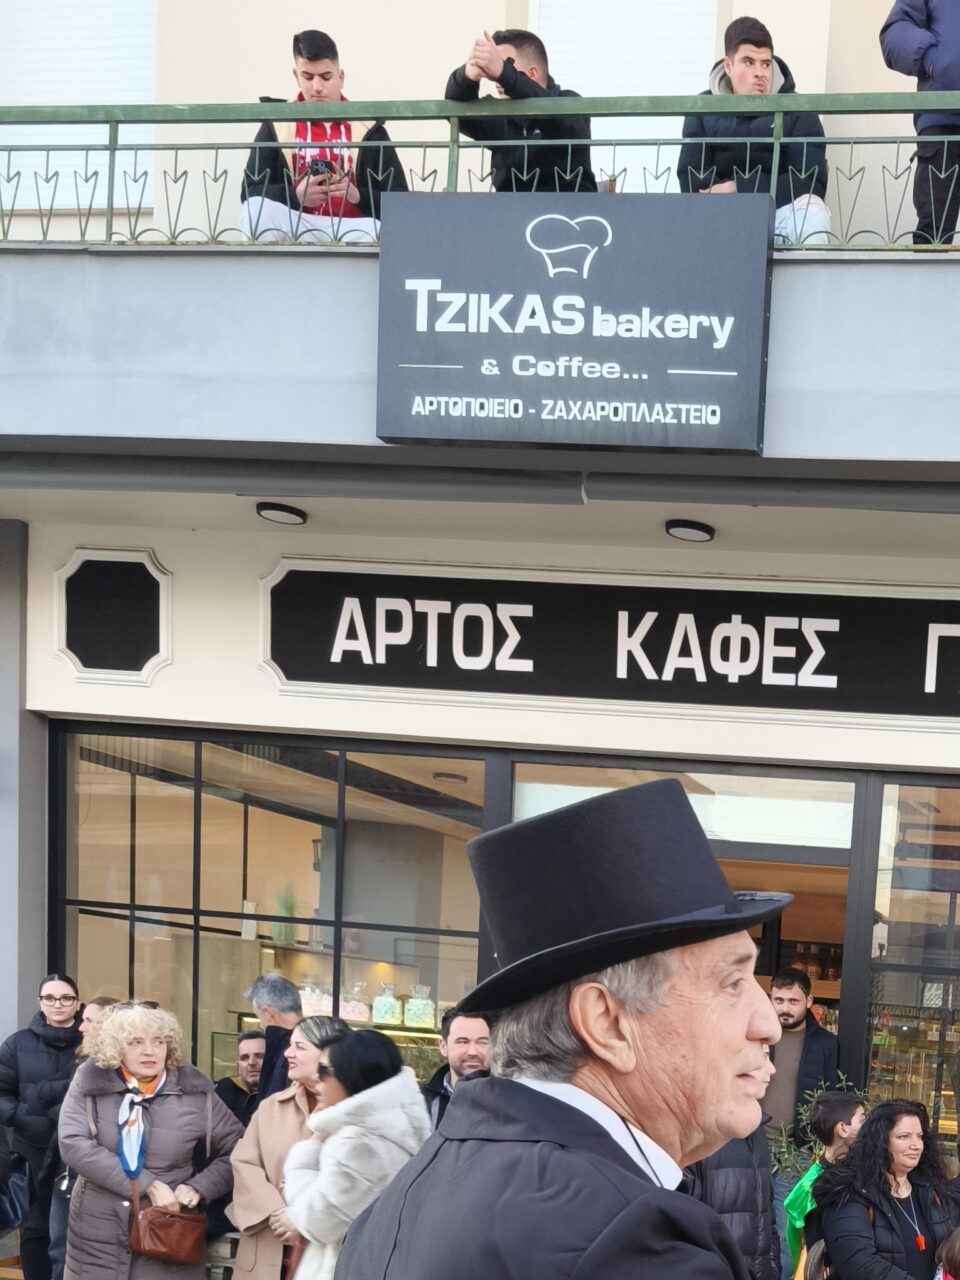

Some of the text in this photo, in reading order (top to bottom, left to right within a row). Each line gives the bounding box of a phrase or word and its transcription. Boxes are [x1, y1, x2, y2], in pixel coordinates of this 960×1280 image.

[404, 278, 735, 349] TZIKAS bakery
[480, 354, 649, 380] & Coffee...
[411, 395, 524, 419] ΑΡΤΟΠΟΙΕΙΟ
[540, 399, 721, 426] ΖΑΧΑΡΟΠΛΑΣΤΕΙΟ
[330, 596, 534, 672] ΑΡΤΟΣ
[615, 610, 840, 689] ΚΑΦΕΣ
